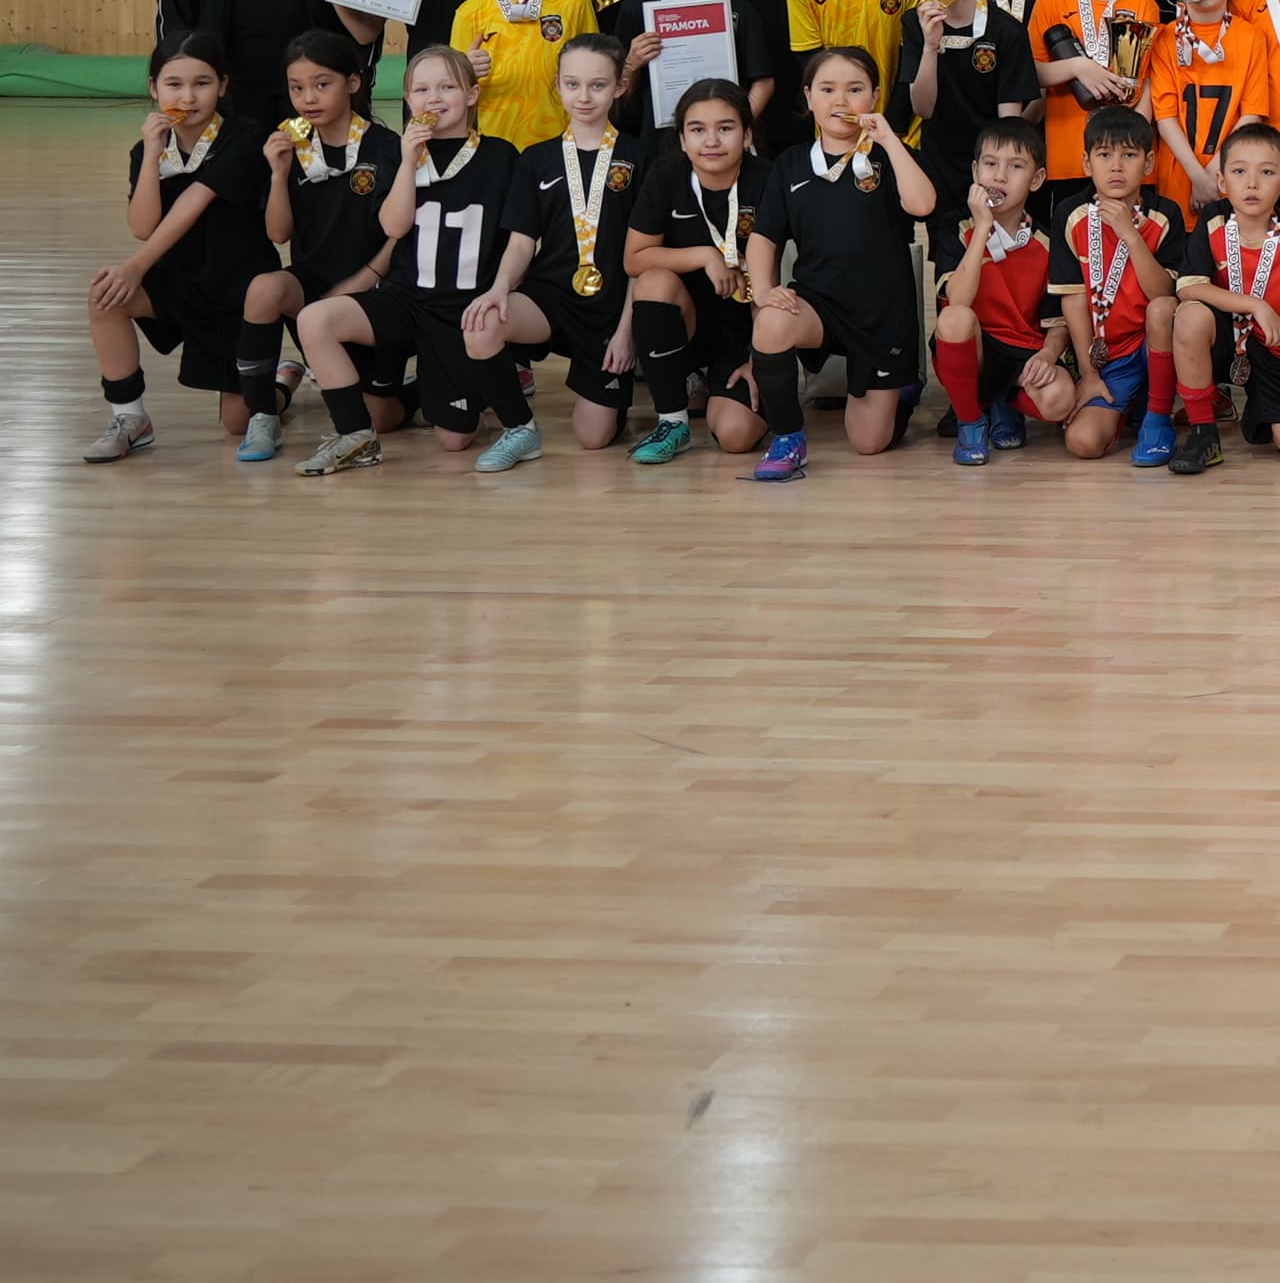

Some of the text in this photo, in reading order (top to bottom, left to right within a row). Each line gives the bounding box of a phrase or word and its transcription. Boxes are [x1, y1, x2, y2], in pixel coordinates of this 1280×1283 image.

[659, 19, 710, 33] ГРАМОТА
[1183, 84, 1232, 155] 17
[415, 201, 483, 290] 11
